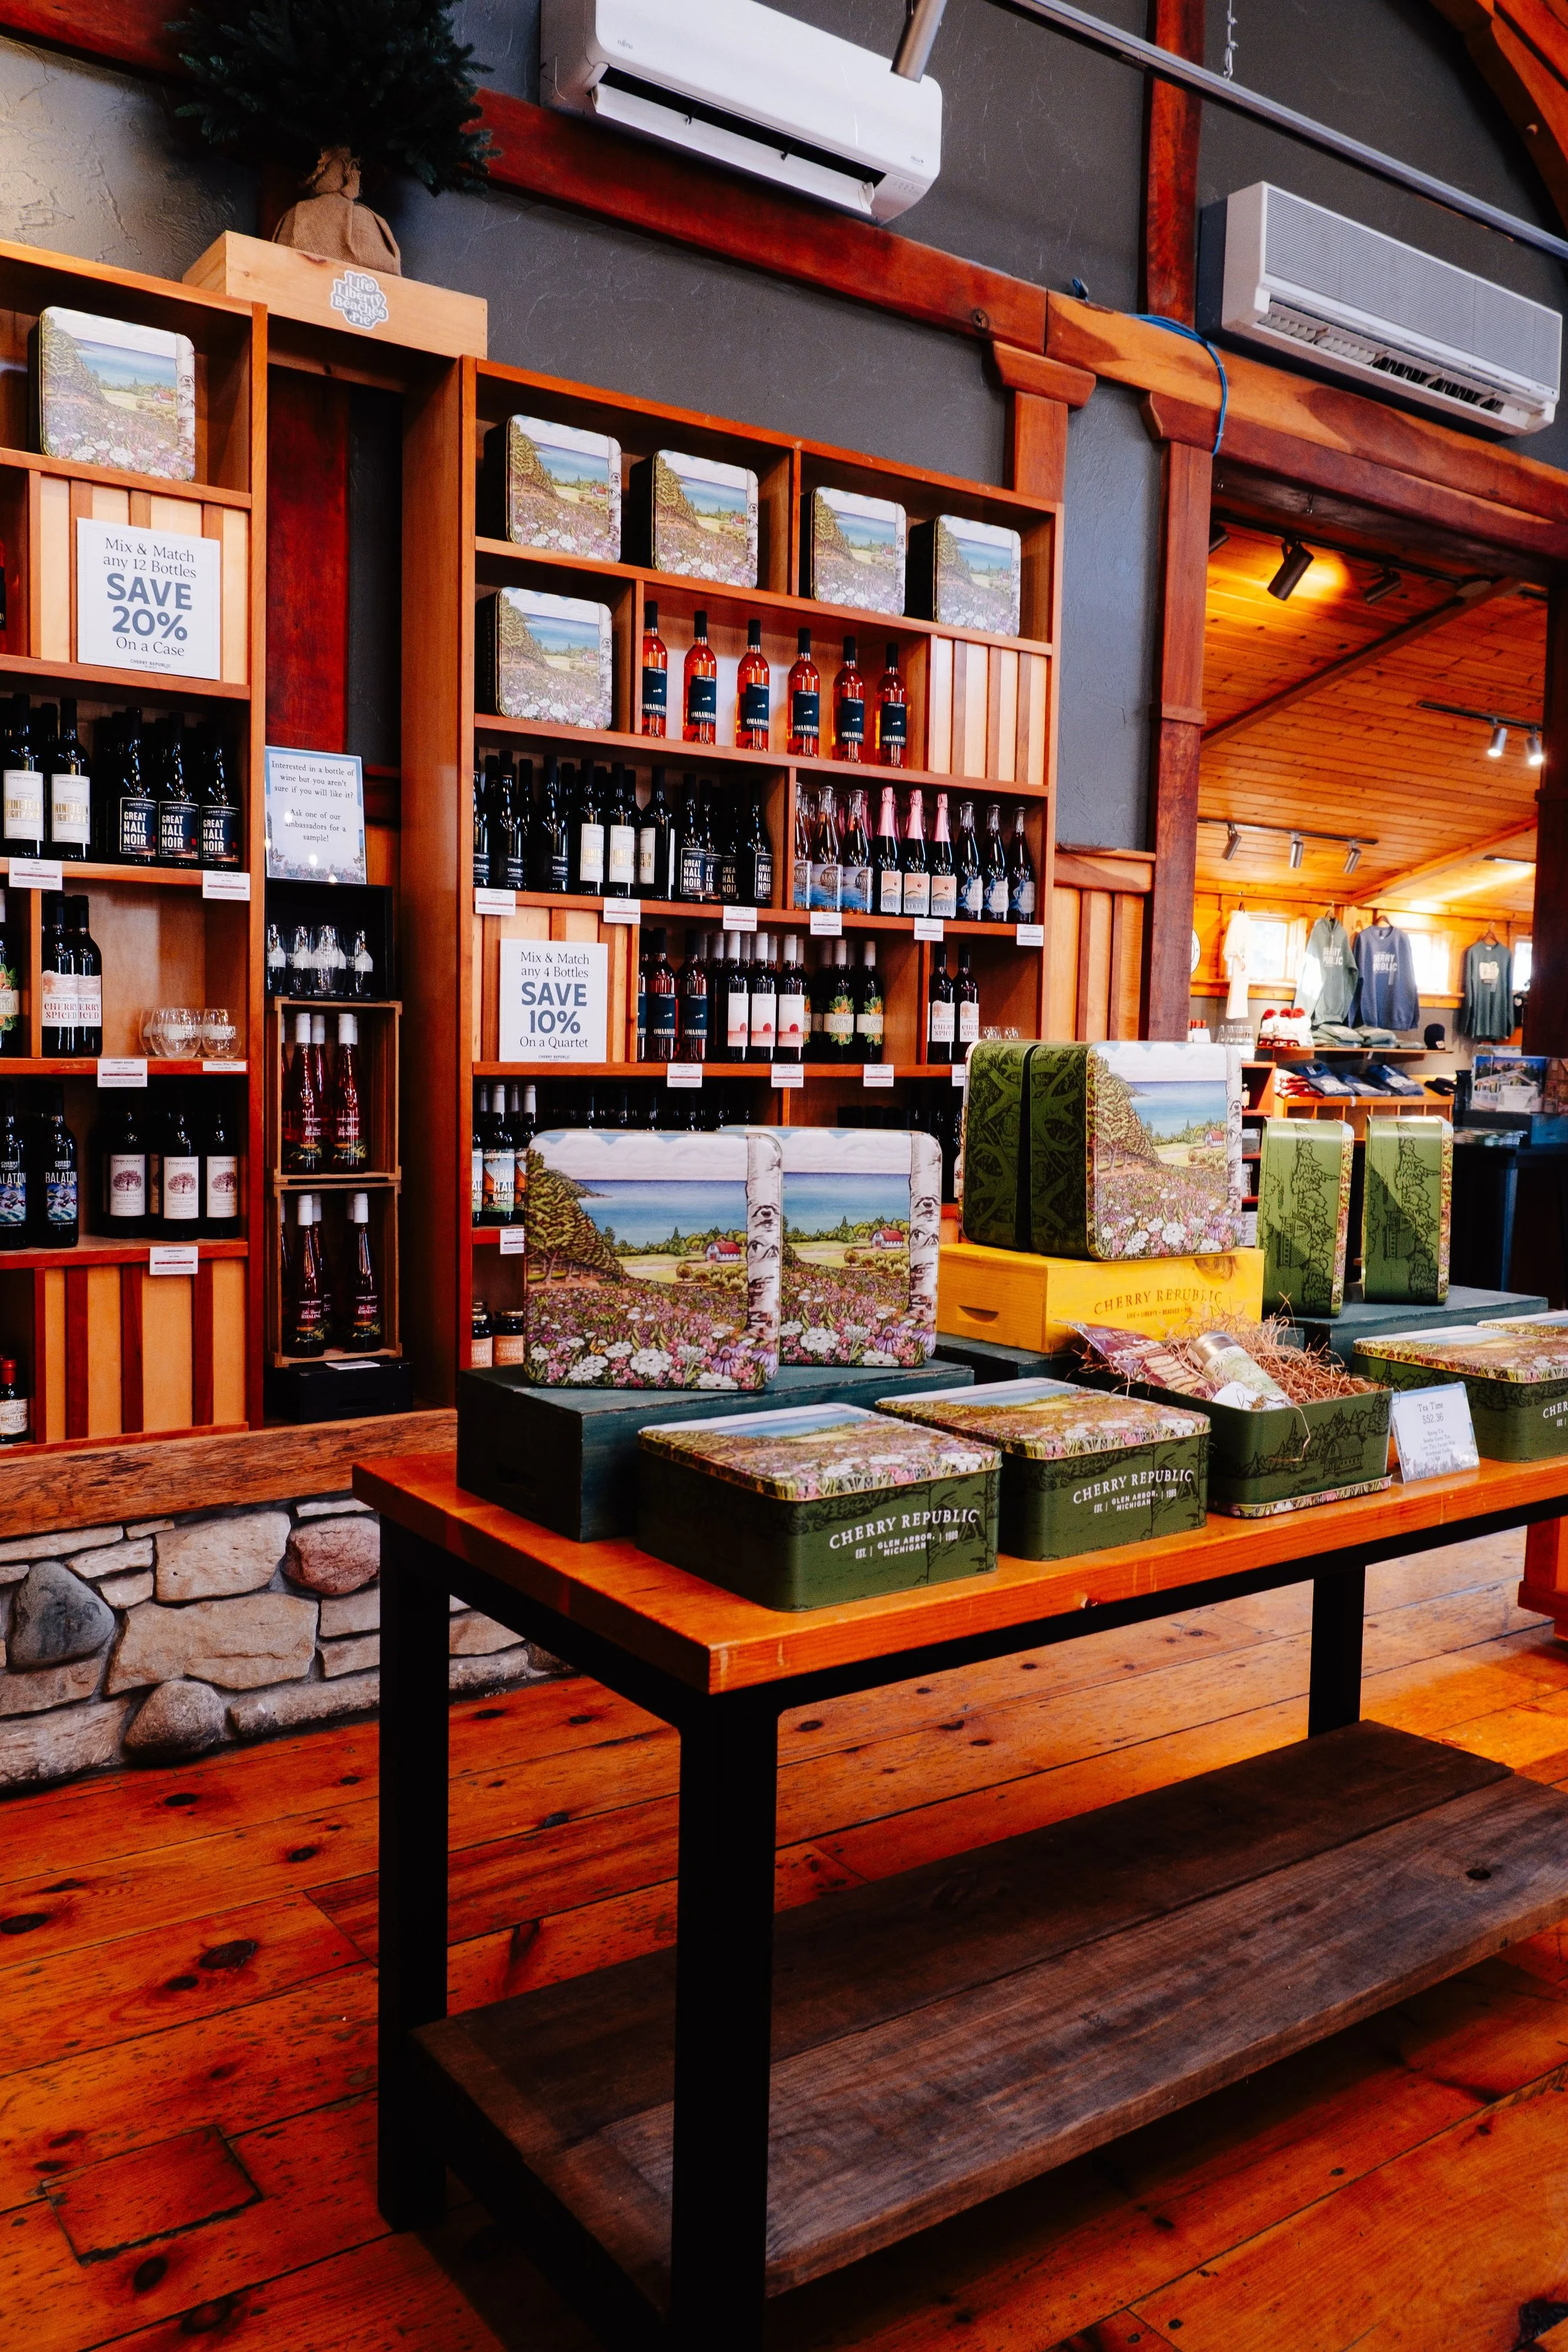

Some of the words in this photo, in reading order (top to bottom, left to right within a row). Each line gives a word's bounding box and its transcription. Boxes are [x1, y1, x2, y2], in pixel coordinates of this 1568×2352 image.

[349, 276, 375, 292] Life
[337, 283, 382, 307] Liberty
[335, 295, 384, 319] Beaches
[349, 311, 371, 326] Pie
[105, 537, 132, 553] Mix
[137, 543, 147, 555] &
[153, 545, 194, 563] Match
[103, 556, 128, 570] any
[134, 559, 146, 571] 12
[151, 560, 196, 578] Bottles
[107, 573, 193, 610] SAVE
[112, 605, 188, 640] 20%
[116, 636, 136, 650] On
[141, 642, 149, 652] a
[153, 641, 184, 657] Case
[149, 660, 171, 669] REPUBLIC
[272, 760, 306, 771] Interested
[325, 766, 345, 776] bottle
[314, 788, 327, 797] will
[330, 790, 342, 798] like
[124, 811, 147, 821] GREAT
[290, 808, 303, 817] Ask
[162, 815, 184, 824] GREAT
[203, 820, 224, 828] GREAT
[124, 821, 147, 834] HALL
[162, 825, 184, 836] HALL
[285, 821, 327, 831] ambassadors
[329, 824, 339, 832] for
[124, 834, 146, 845] NOIR
[203, 829, 224, 840] HALL
[303, 834, 329, 843] sample!
[162, 837, 183, 848] NOIR
[203, 840, 224, 852] NOIR
[684, 859, 701, 867] GREAT
[684, 867, 701, 877] HALL
[684, 877, 701, 887] NOIR
[521, 951, 541, 963] Mix
[545, 953, 553, 963] &
[558, 953, 589, 965] Match
[521, 968, 540, 978] any
[544, 967, 549, 977] 4
[554, 966, 588, 978] Bottles
[521, 981, 587, 1006] SAVE
[529, 1010, 581, 1034] 10%
[520, 1036, 536, 1047] On
[548, 1036, 588, 1049] Quartet
[45, 1171, 77, 1183] BALATON
[1094, 1291, 1151, 1315] CHERRY
[1157, 1288, 1222, 1304] REPUBLIC
[1417, 1404, 1428, 1412] Tea
[1429, 1401, 1444, 1410] Time
[1543, 1401, 1568, 1419] CHER
[1422, 1412, 1444, 1424] $52.36
[1073, 1475, 1126, 1504] CHERRY
[1131, 1470, 1194, 1486] REPUBLIC
[1111, 1496, 1129, 1505] GLEN
[1133, 1490, 1158, 1501] ARBOR,
[1166, 1488, 1177, 1498] 1989
[1116, 1498, 1151, 1512] MICHIGAN
[829, 1517, 897, 1549] CHERRY
[901, 1509, 980, 1529] REPUBLIC
[877, 1539, 900, 1550] GLEN
[903, 1532, 935, 1544] ARBOR,
[945, 1530, 958, 1542] 1989
[883, 1543, 926, 1557] MICHIGAN
